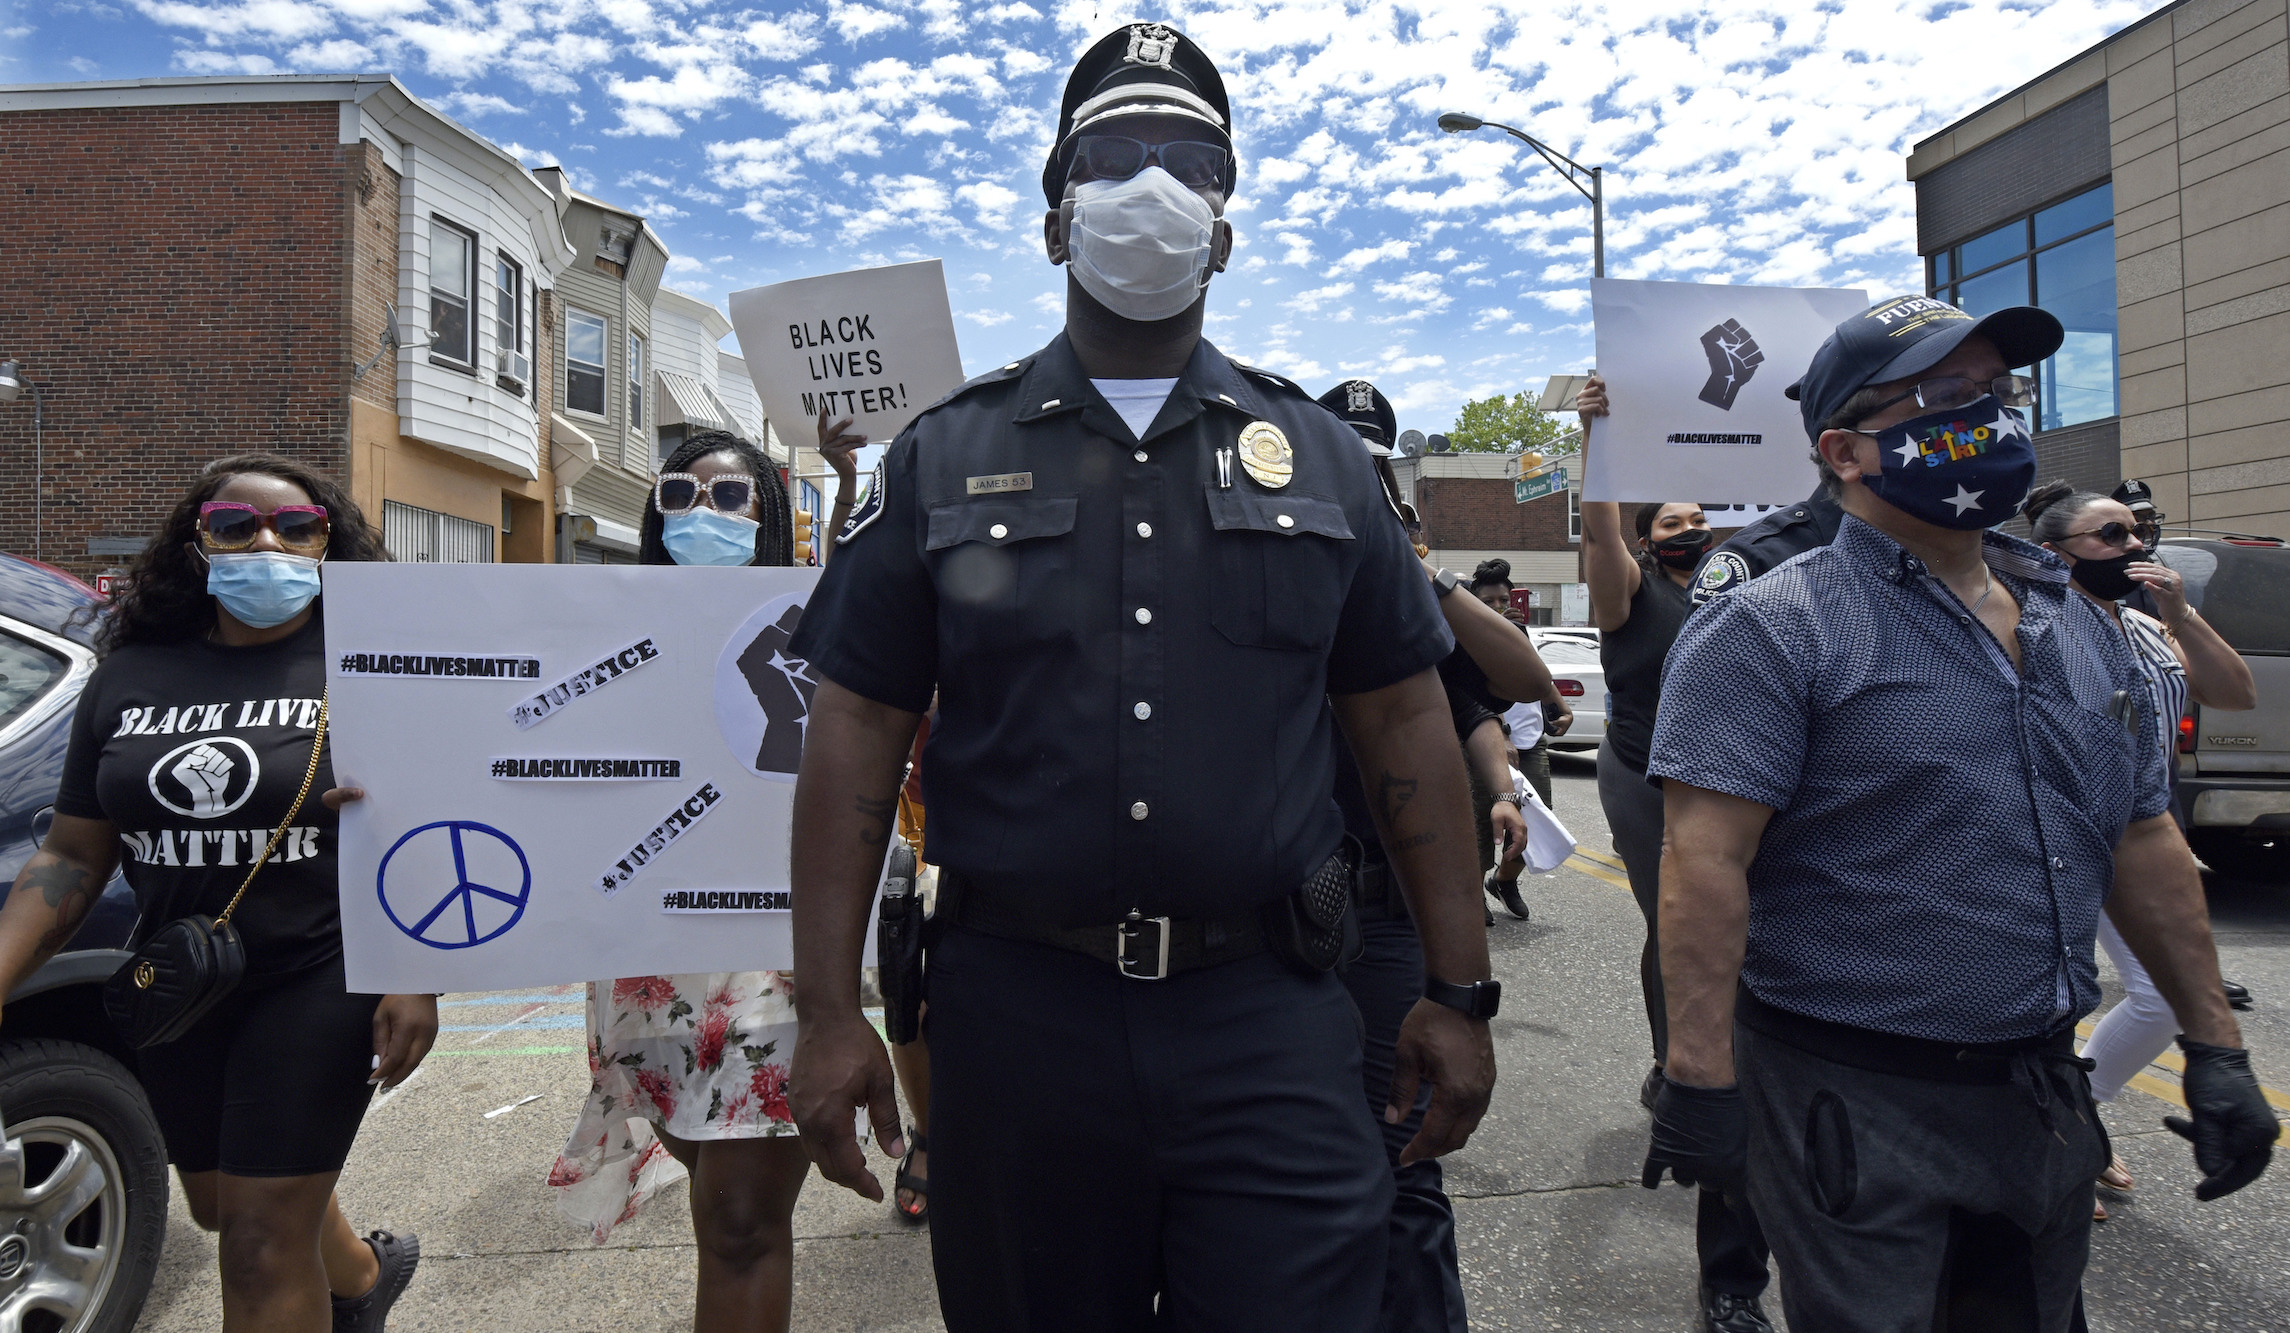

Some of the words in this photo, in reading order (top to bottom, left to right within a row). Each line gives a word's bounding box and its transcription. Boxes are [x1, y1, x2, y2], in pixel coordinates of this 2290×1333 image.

[789, 314, 875, 349] BLACK
[808, 350, 883, 381] LIVES
[801, 383, 908, 416] MATTER!
[1667, 433, 1762, 445] #BLACKLIVESMATTER
[1926, 420, 1968, 439] THE
[973, 479, 1009, 490] JAMES
[1012, 478, 1026, 487] 53
[341, 654, 540, 678] #BLACKLIVESMATTER
[514, 638, 658, 727] #JUSTICE
[113, 703, 231, 738] BLACK
[2208, 736, 2257, 746] YUKON
[491, 759, 681, 778] #BLACKLIVESMATTER
[120, 826, 320, 867] MATTER
[602, 782, 721, 894] #JUSTICE
